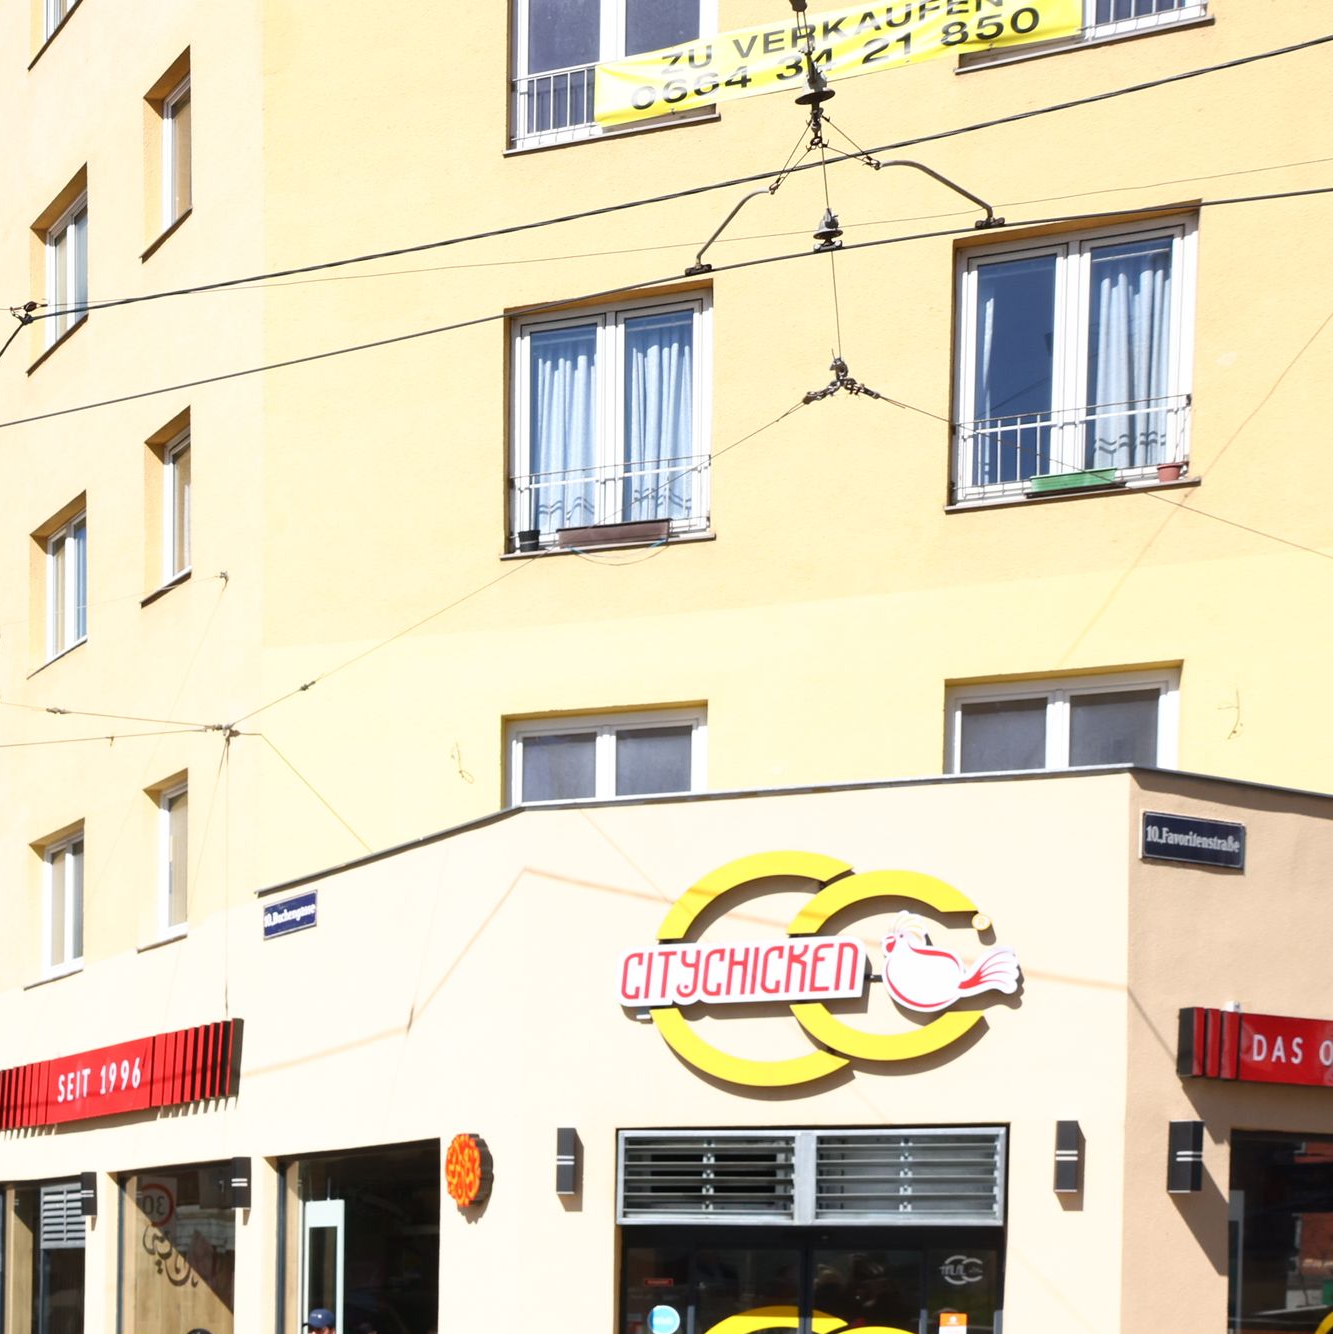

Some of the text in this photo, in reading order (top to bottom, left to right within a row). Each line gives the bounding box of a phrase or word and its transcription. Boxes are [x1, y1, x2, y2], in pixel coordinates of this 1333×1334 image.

[632, 65, 752, 110] 0664
[862, 32, 911, 64] 21
[941, 7, 1040, 46] 850
[661, 0, 1004, 74] ZU VERKAUFEN
[620, 942, 859, 1000] CITYCHICKEN
[1252, 1033, 1303, 1065] DAS
[57, 1057, 141, 1103] SEIT 1996
